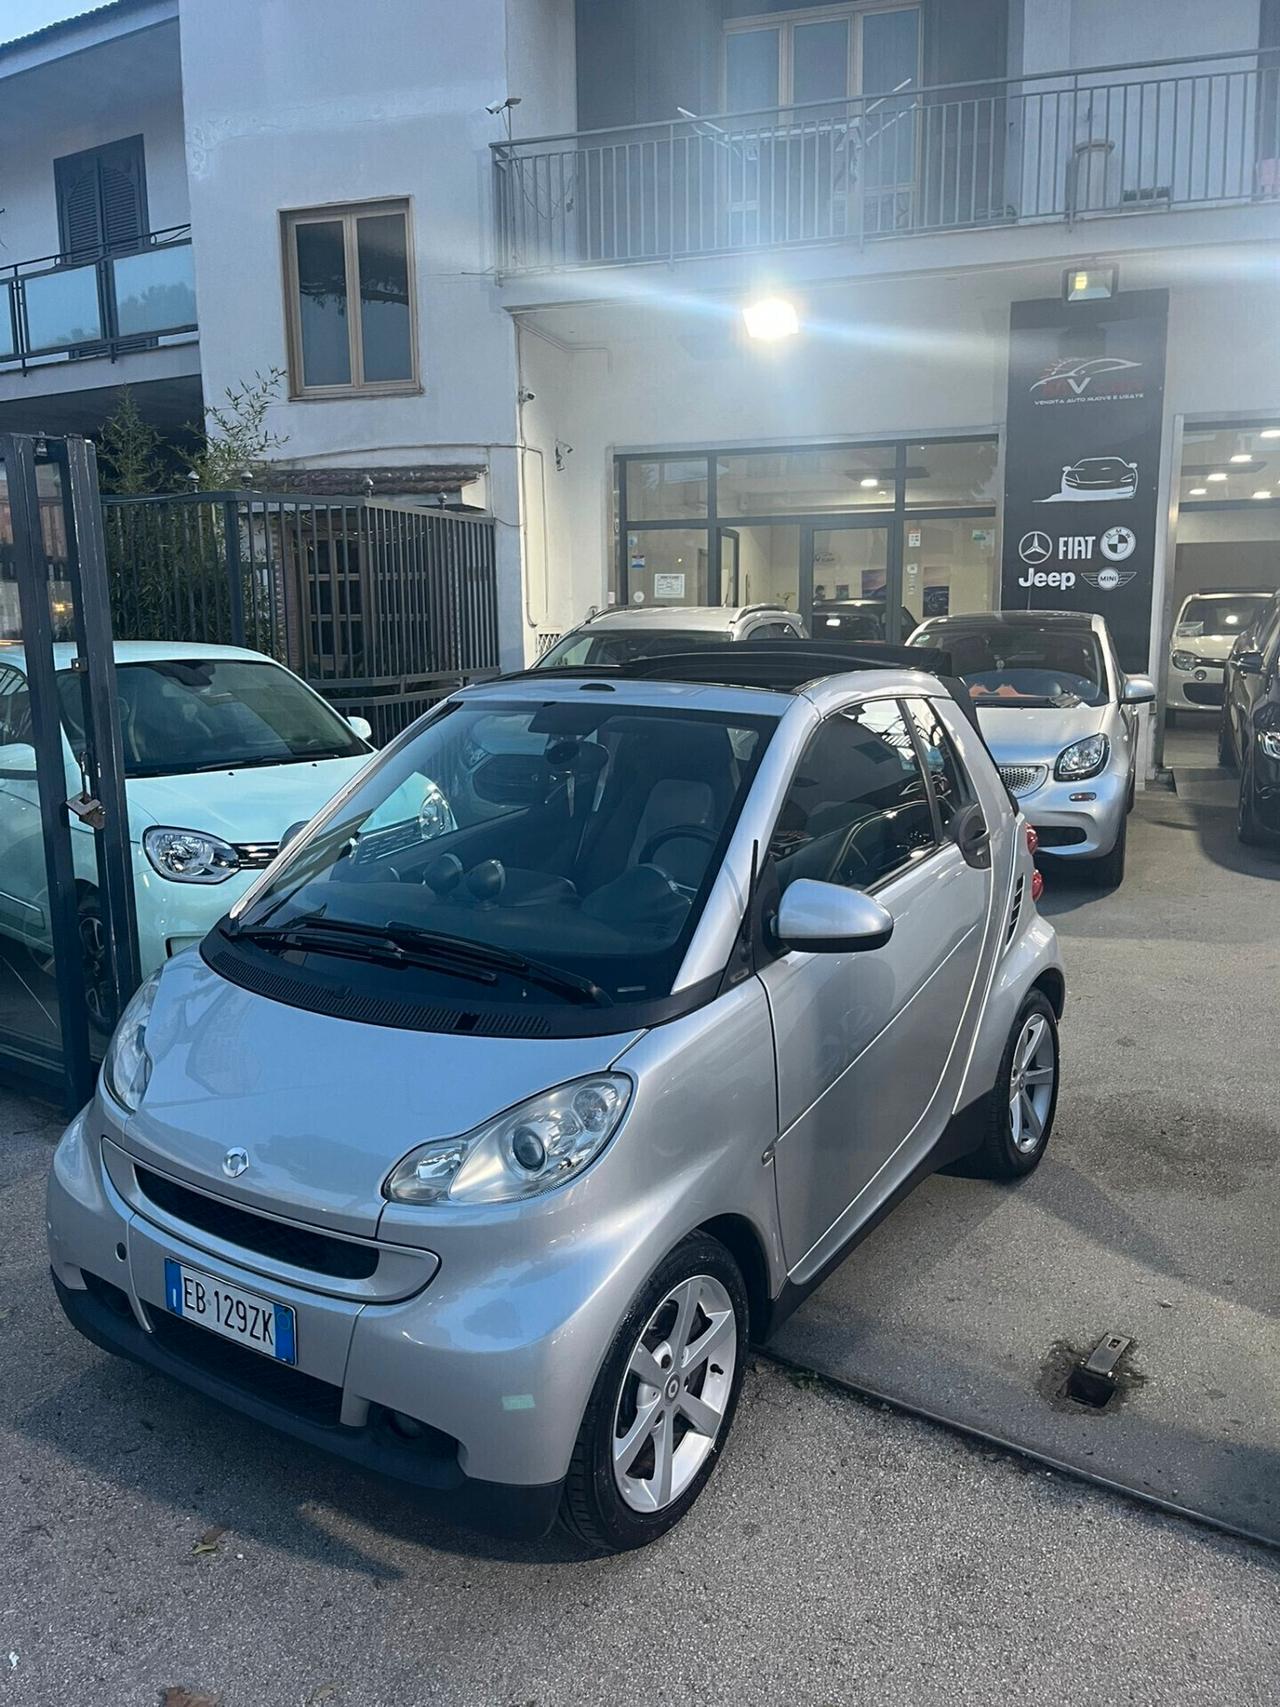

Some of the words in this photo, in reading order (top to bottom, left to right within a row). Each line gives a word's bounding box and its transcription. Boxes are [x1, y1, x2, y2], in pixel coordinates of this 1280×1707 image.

[1058, 536, 1096, 560] FIAT
[1018, 567, 1076, 591] Jeep
[183, 1276, 206, 1314] EB
[214, 1290, 274, 1346] 129ZK
